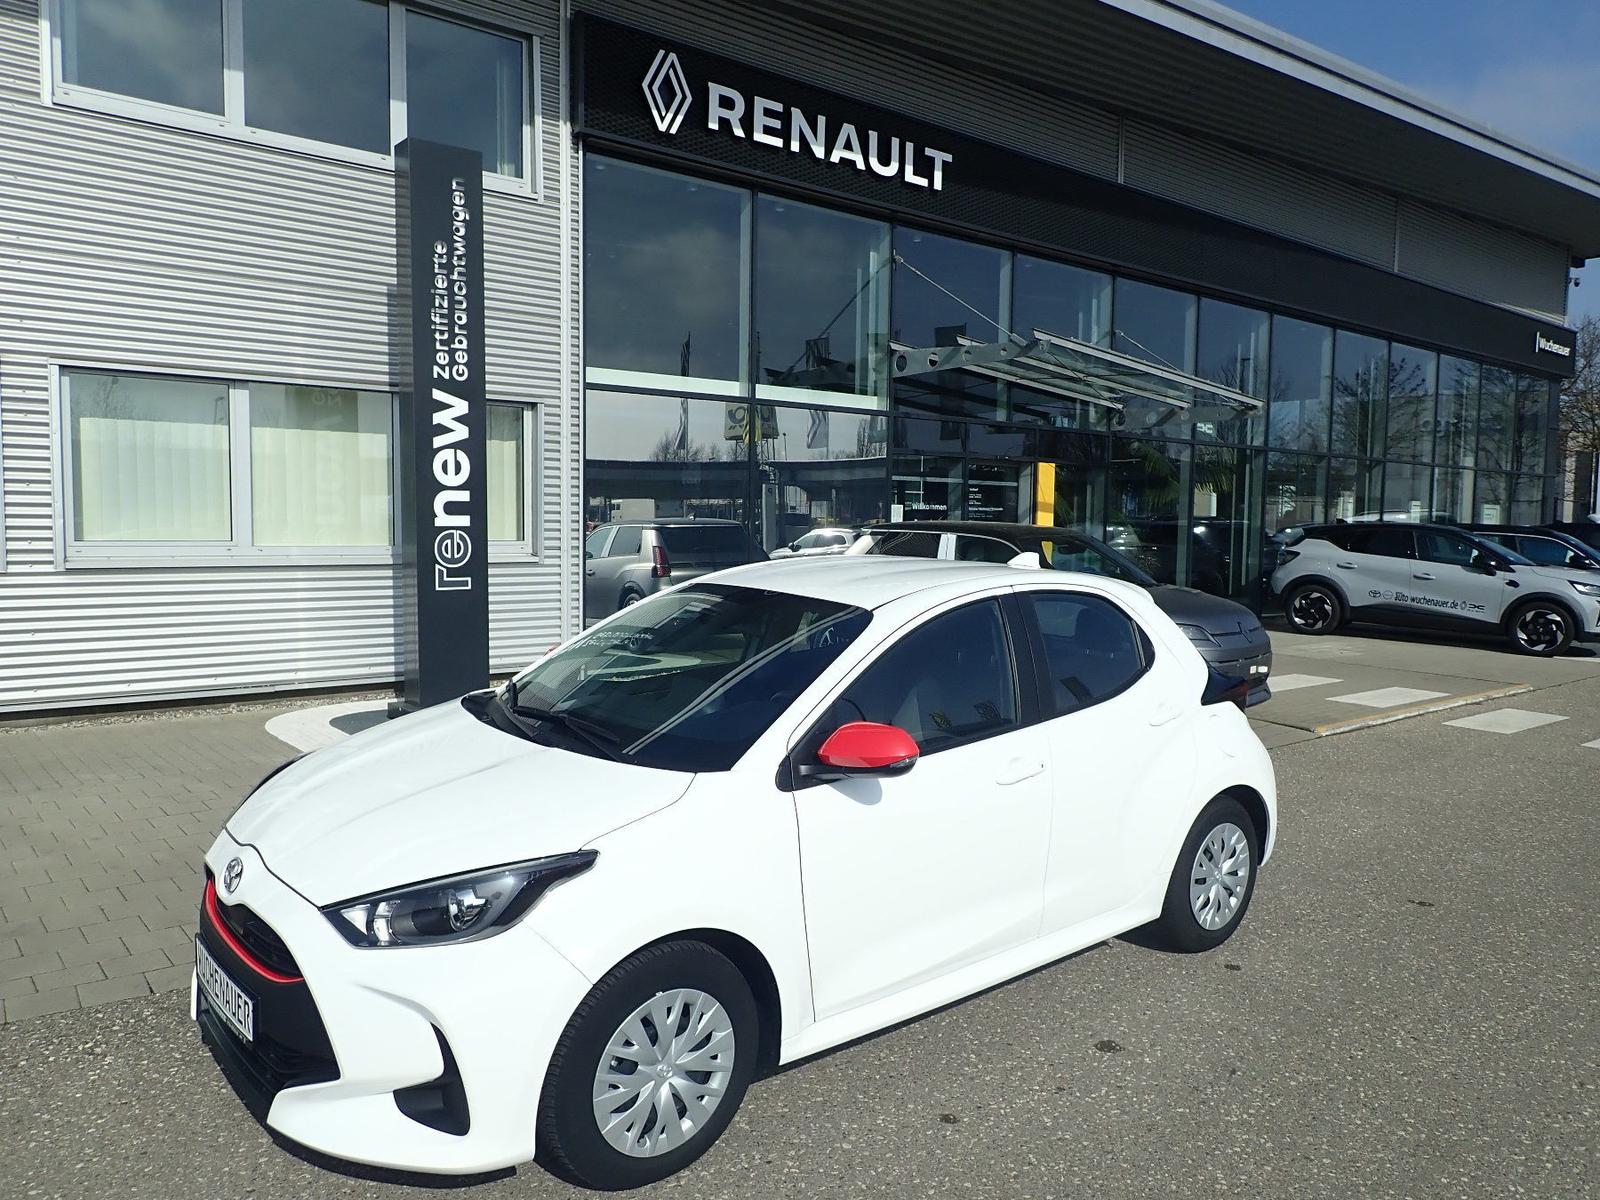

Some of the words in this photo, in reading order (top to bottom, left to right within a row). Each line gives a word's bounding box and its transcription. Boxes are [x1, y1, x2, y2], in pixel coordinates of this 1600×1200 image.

[707, 81, 953, 191] RENAULT
[430, 239, 450, 380] Zertifizierte
[450, 176, 470, 382] Gebrauchtwagen
[431, 388, 472, 591] renew
